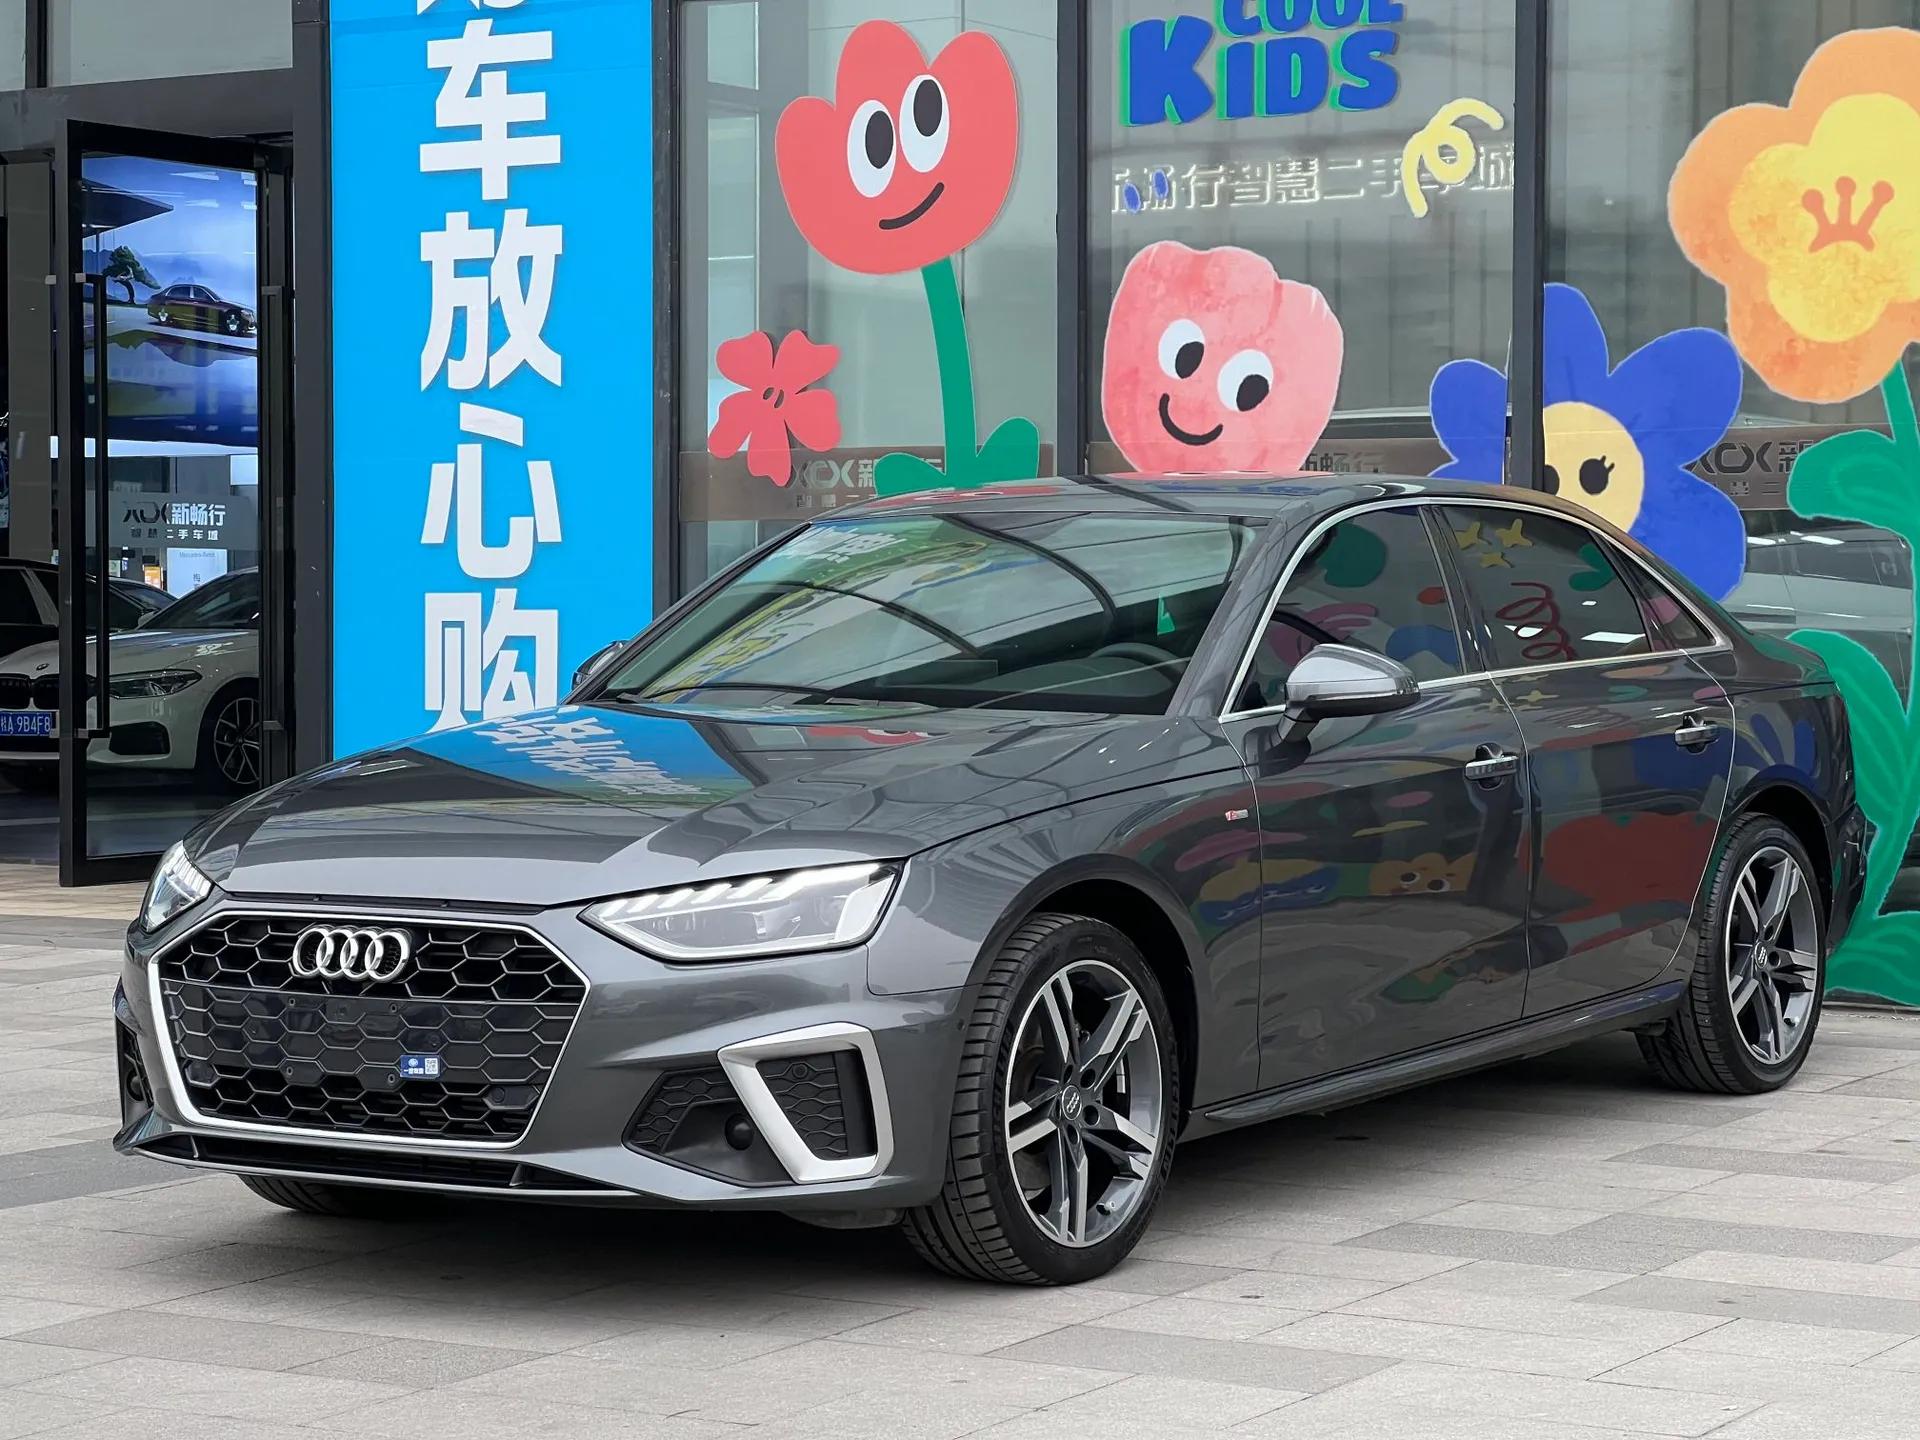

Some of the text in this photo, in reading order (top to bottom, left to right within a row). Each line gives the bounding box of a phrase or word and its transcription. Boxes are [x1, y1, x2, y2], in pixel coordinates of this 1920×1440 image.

[1120, 15, 1400, 127] KIDS
[417, 0, 562, 734] 车放心购
[171, 503, 227, 527] 新畅行
